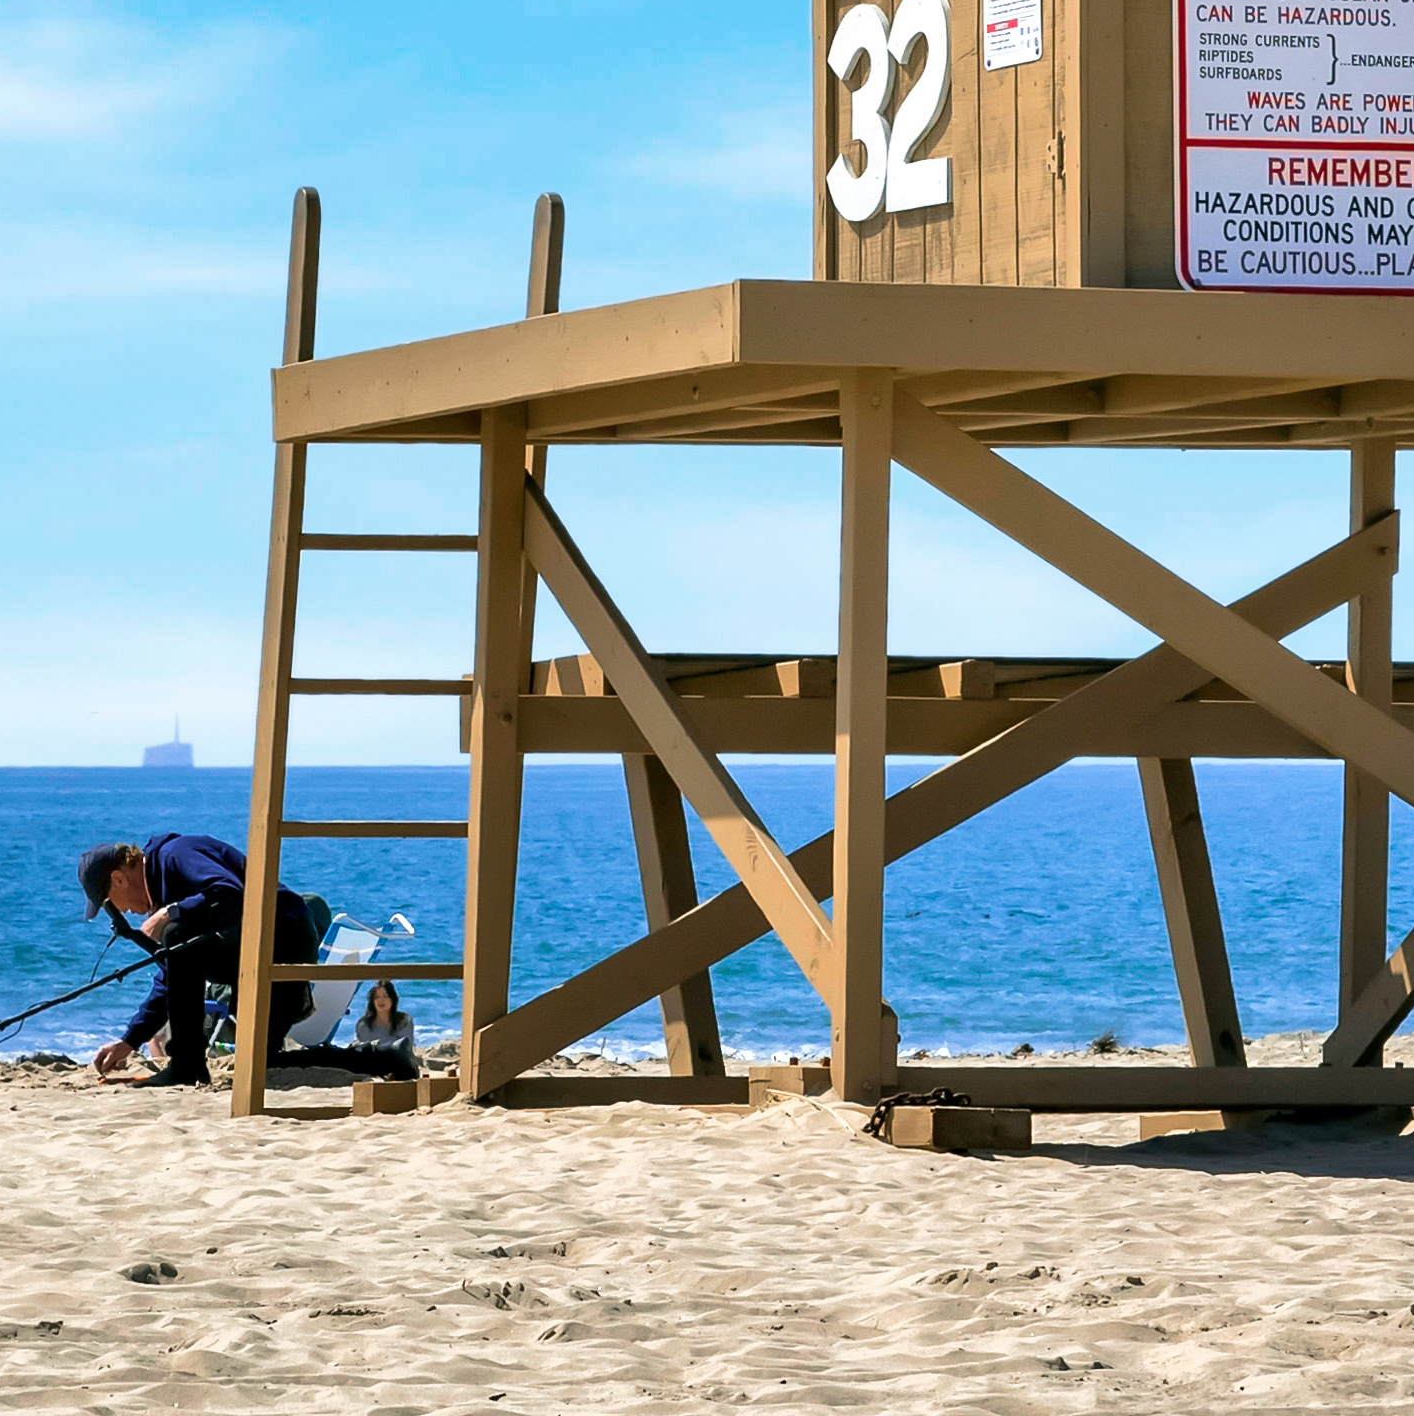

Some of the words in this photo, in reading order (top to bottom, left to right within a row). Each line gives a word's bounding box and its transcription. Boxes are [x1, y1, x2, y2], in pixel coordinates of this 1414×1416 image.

[1196, 5, 1233, 23] CAN
[1244, 6, 1267, 24] BE
[1278, 7, 1396, 27] HAZARDOUS.
[1199, 33, 1248, 46] STRONG
[1255, 35, 1320, 48] CURRENTS
[1199, 50, 1254, 63] RIPTIDES
[1199, 66, 1282, 81] SURFBOARDS
[1247, 92, 1306, 110] WAVES
[1316, 93, 1353, 111] ARE
[1205, 113, 1252, 132] THEY
[1263, 115, 1300, 133] CAN
[1312, 116, 1369, 134] BADLY
[1195, 192, 1335, 217] HAZARDOUS
[1348, 196, 1394, 219] AND
[1223, 220, 1354, 244] CONDITIONS
[1368, 225, 1414, 246] MAY
[1198, 250, 1228, 273] BE
